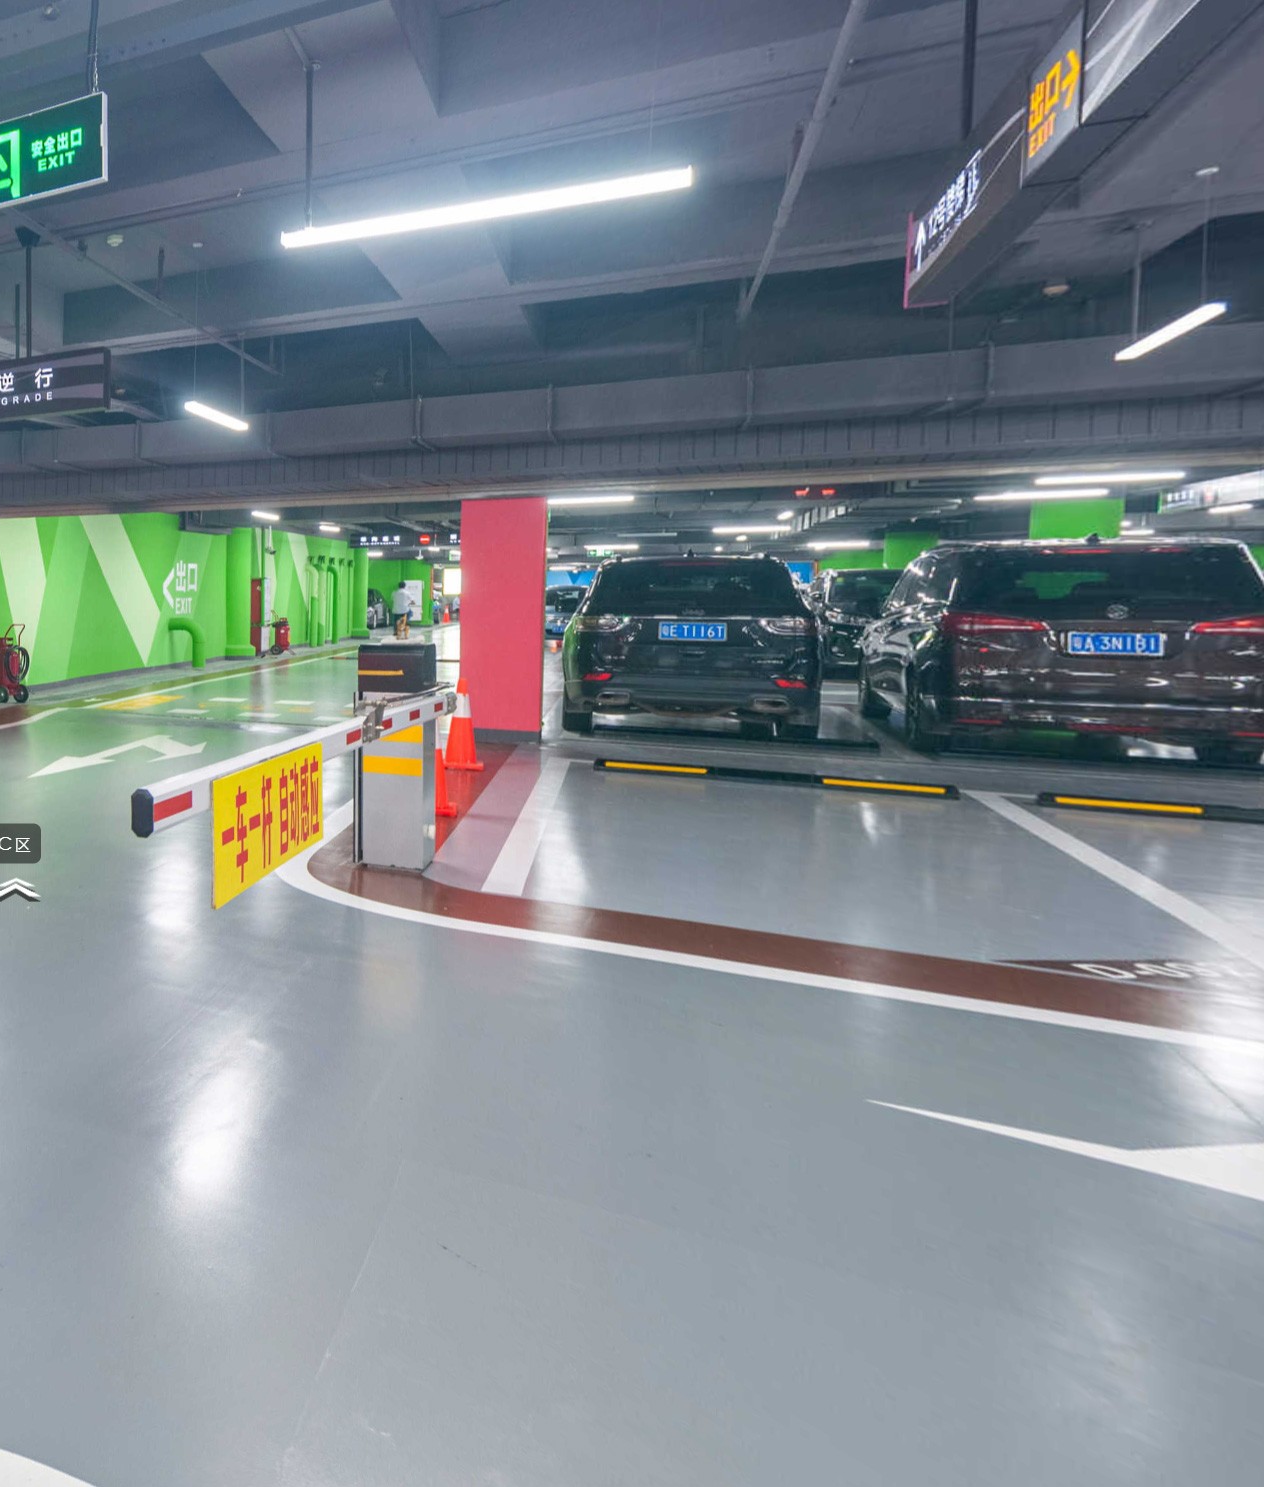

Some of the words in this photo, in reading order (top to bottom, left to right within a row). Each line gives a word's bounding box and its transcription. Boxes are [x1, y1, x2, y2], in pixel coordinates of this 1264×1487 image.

[1029, 61, 1061, 132] 出口
[31, 127, 82, 159] 安全出口
[1029, 112, 1056, 158] EXIT
[38, 151, 76, 172] EXIT
[176, 560, 198, 592] 出口
[176, 597, 193, 615] EXIT
